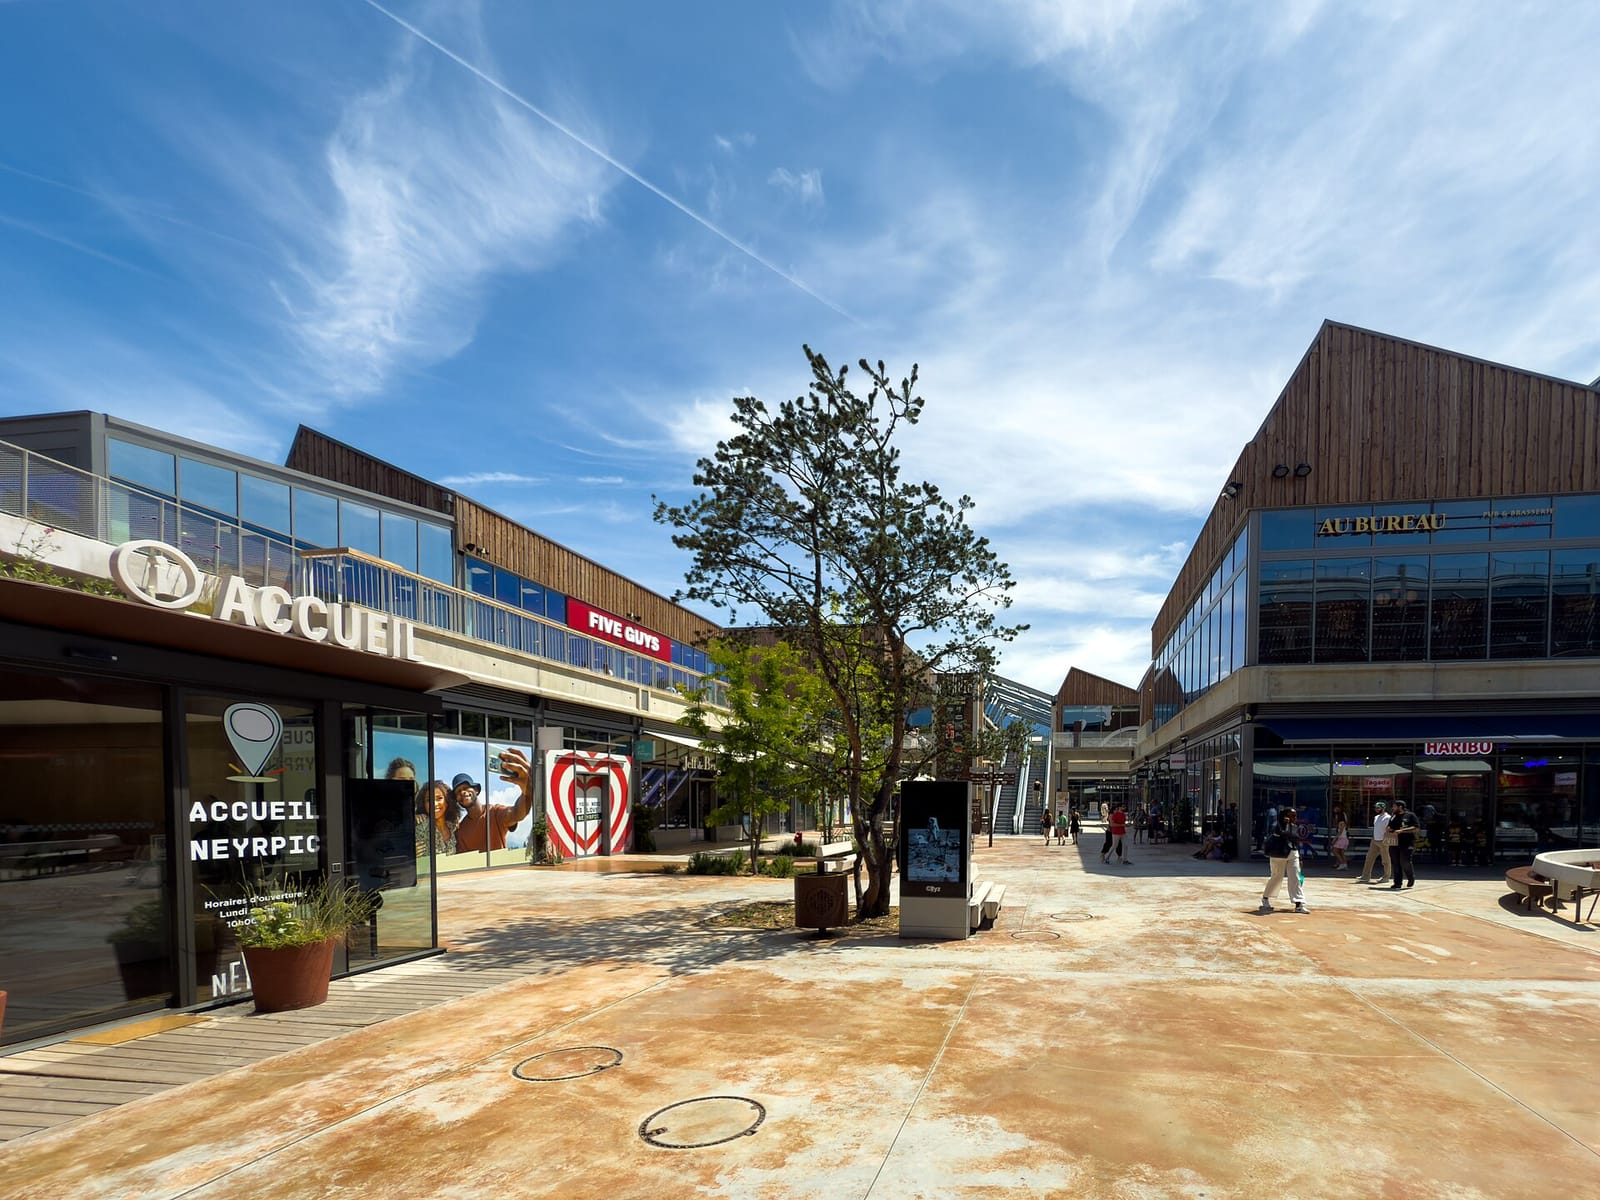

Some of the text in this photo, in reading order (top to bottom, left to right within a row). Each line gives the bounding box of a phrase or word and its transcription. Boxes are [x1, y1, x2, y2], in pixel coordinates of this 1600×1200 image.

[1320, 513, 1446, 534] AU BUREAU
[1482, 510, 1499, 518] PUB
[212, 574, 424, 662] ACCUEIL
[588, 611, 660, 651] FIVE GUYS
[1425, 742, 1492, 755] HARIBO
[682, 756, 698, 771] Jeff
[189, 801, 319, 822] ACCUEIL
[190, 835, 320, 861] NEYRPIC
[204, 897, 247, 909] Horaires
[249, 891, 303, 904] d'ouverture
[219, 907, 249, 918] Lundi
